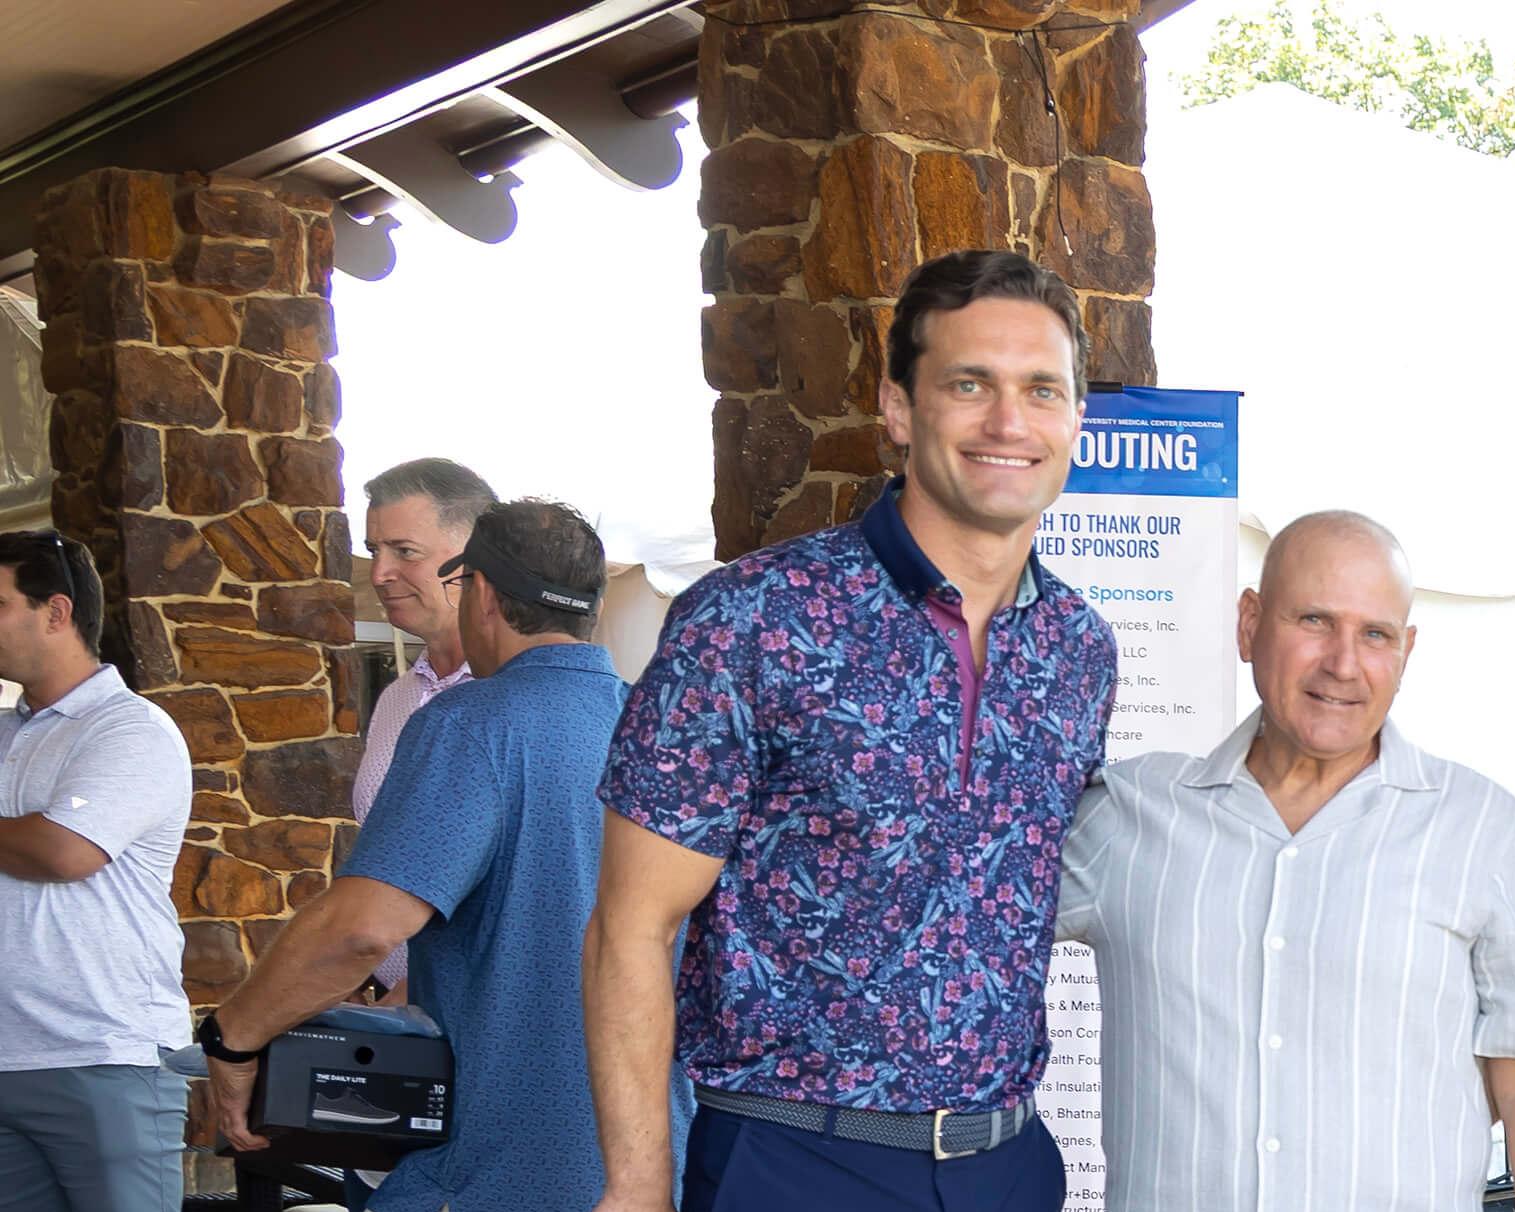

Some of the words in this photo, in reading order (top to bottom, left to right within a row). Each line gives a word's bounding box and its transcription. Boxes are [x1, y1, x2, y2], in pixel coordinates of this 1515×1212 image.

[1118, 418, 1149, 426] MEDICAL
[1150, 419, 1178, 427] CENTER
[1178, 420, 1224, 429] FOUNDATION
[1073, 430, 1197, 471] OUTING
[1060, 513, 1080, 532] TO
[1087, 514, 1141, 534] THANK
[1147, 515, 1181, 535] OUR
[1071, 538, 1159, 558] SPONSORS
[1089, 585, 1174, 605] Sponsors
[1156, 620, 1179, 631] Inc.
[1123, 647, 1147, 658] LLC
[1137, 675, 1160, 686] Inc.
[1173, 703, 1196, 714] Inc.
[1063, 946, 1092, 957] New
[1059, 1000, 1067, 1011] &
[433, 1084, 446, 1095] 10
